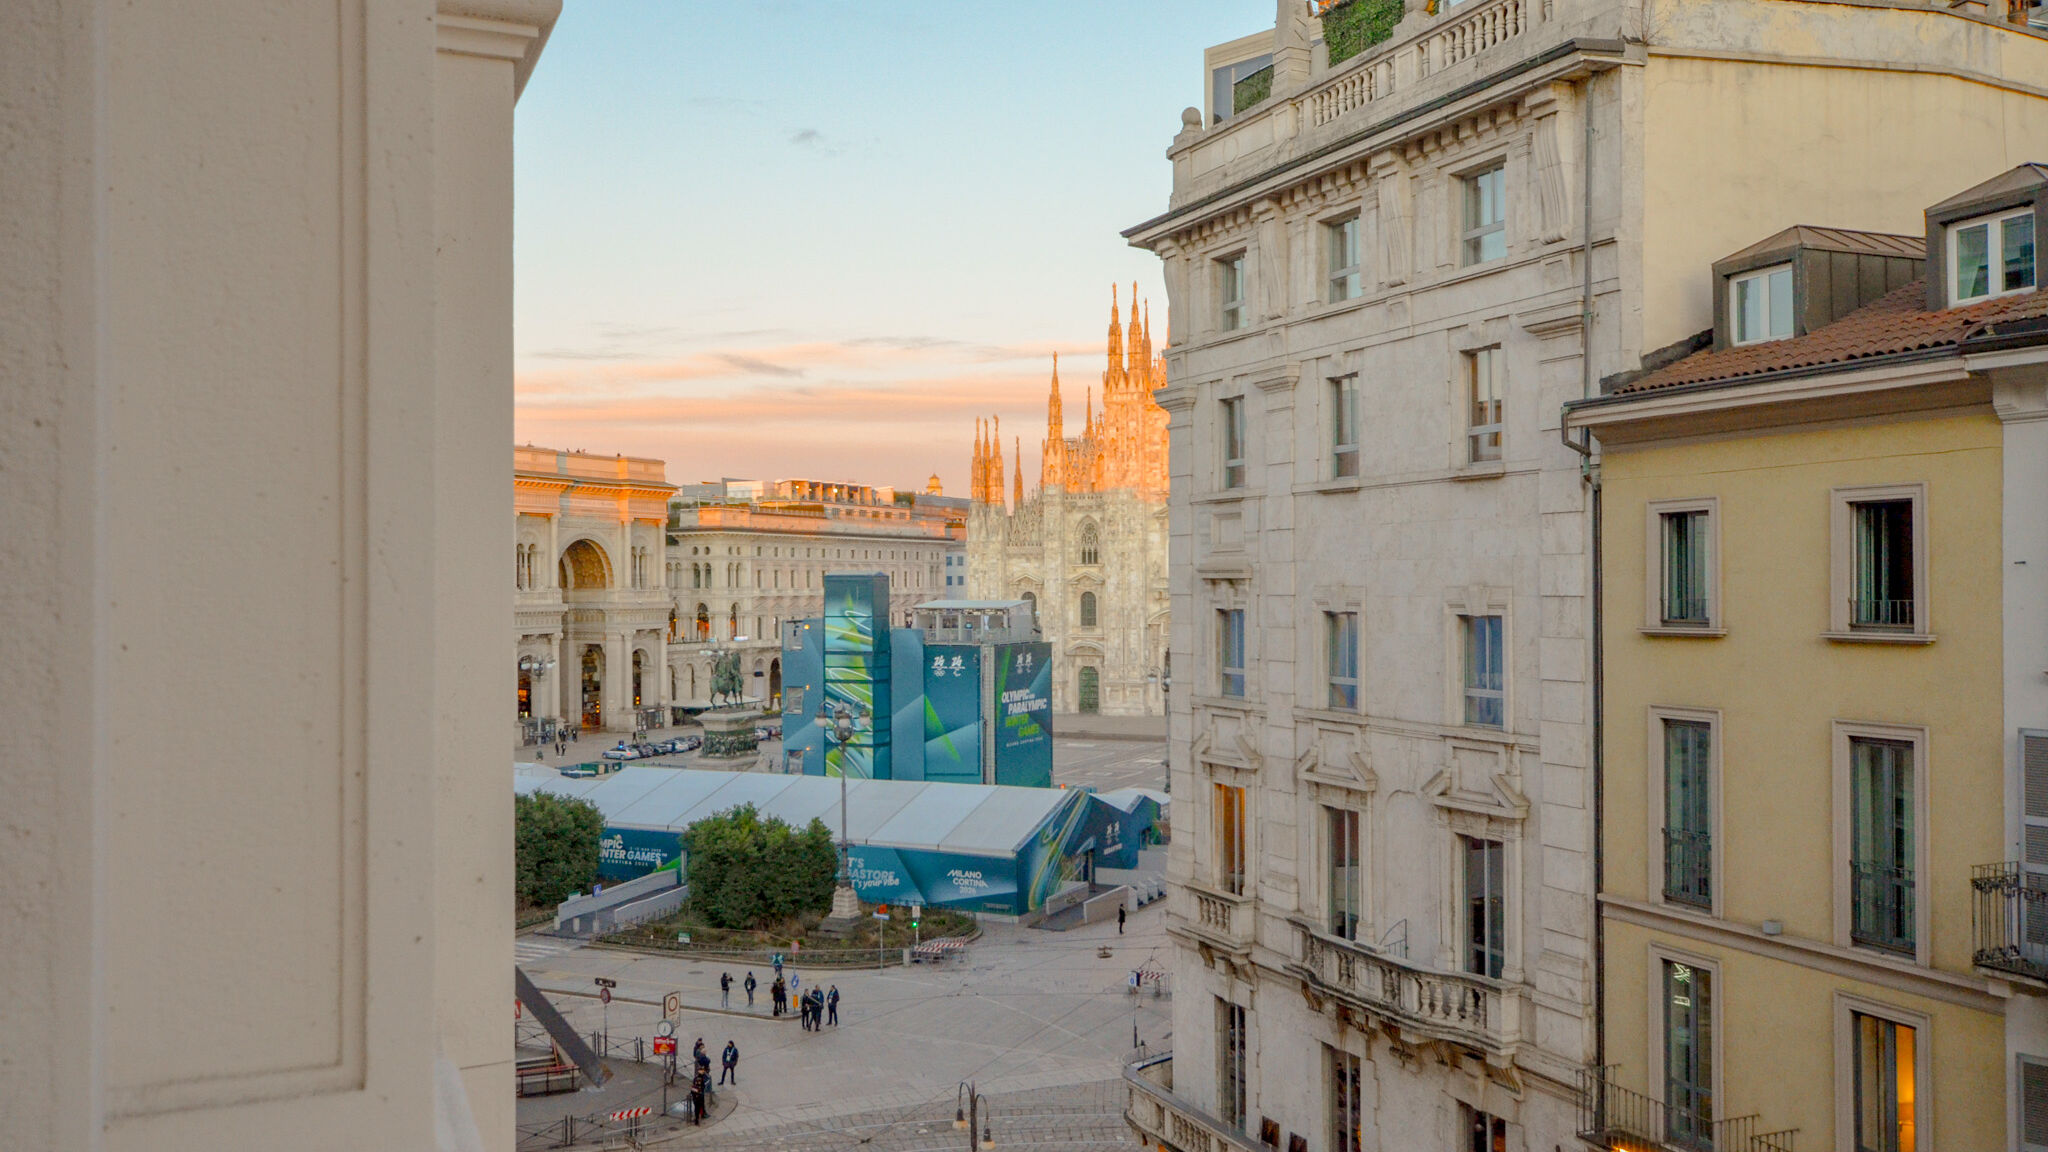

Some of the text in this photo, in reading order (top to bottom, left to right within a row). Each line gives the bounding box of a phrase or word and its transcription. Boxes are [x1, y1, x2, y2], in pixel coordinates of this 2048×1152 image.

[1002, 689, 1030, 703] OLYMPIC
[1008, 698, 1048, 715] PARALYMPIC
[947, 869, 983, 879] MILANO
[953, 878, 989, 888] CORTINA
